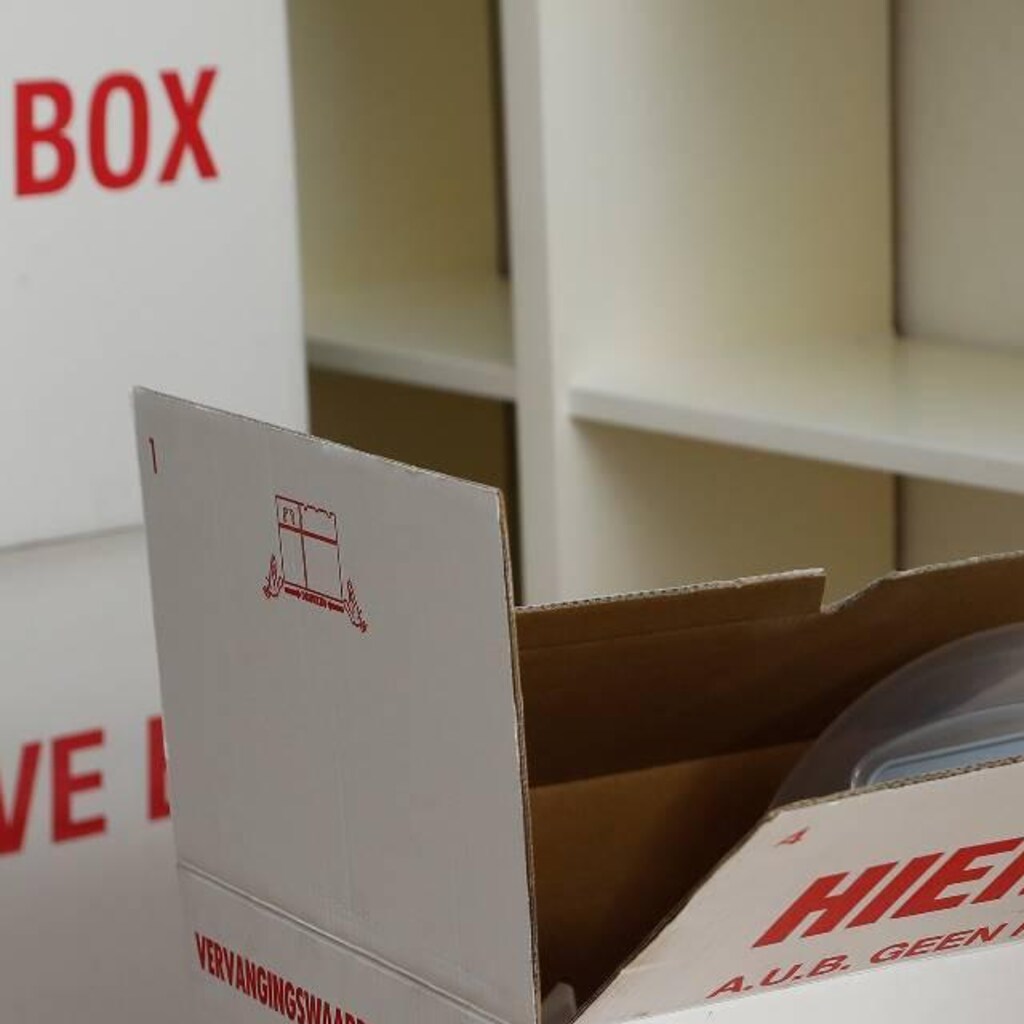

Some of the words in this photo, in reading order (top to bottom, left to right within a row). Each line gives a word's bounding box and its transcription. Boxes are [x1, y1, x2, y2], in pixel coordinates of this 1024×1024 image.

[12, 66, 220, 200] BOX
[706, 953, 849, 999] A.U.B.
[870, 921, 1009, 965] GEEN
